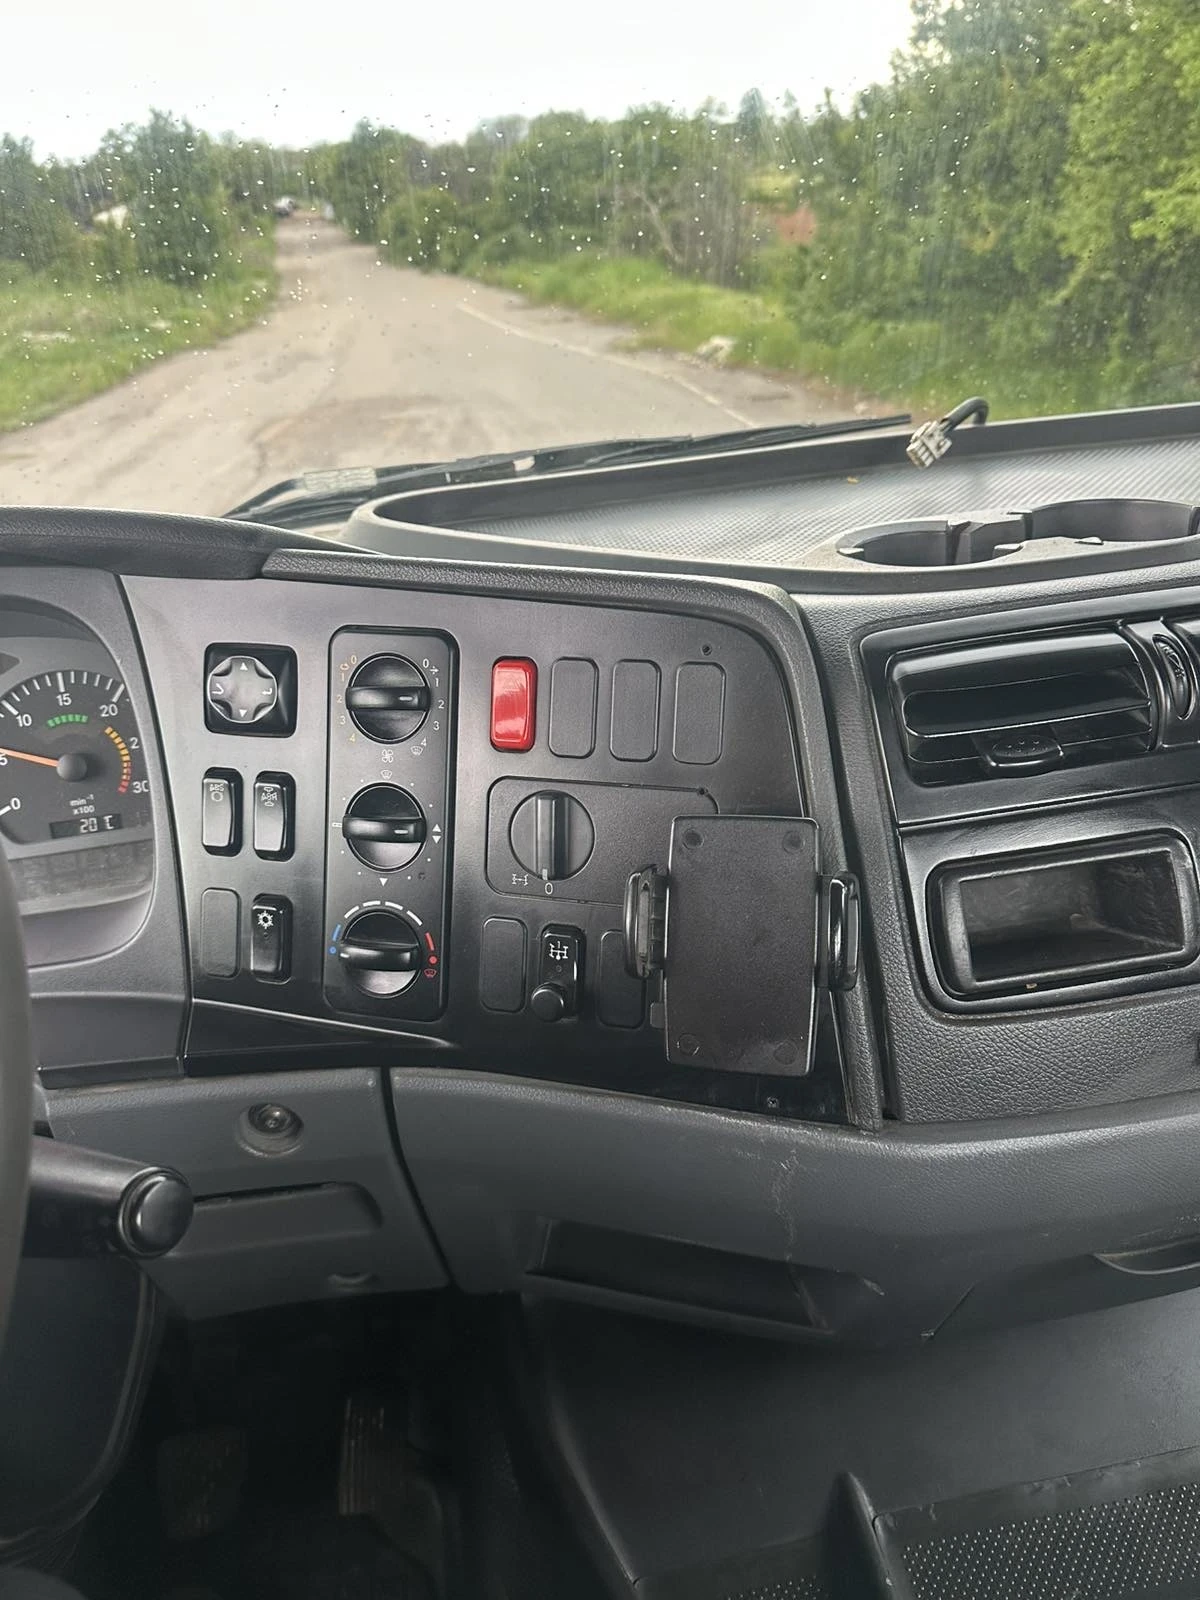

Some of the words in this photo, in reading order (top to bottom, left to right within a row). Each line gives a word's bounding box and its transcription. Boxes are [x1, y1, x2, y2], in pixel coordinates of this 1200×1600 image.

[423, 659, 429, 668] 0
[56, 693, 72, 706] 15
[438, 700, 445, 709] 2
[99, 704, 118, 717] 20
[16, 714, 32, 727] 10
[433, 720, 440, 731] 3
[10, 797, 21, 810] 0
[80, 817, 98, 833] 20
